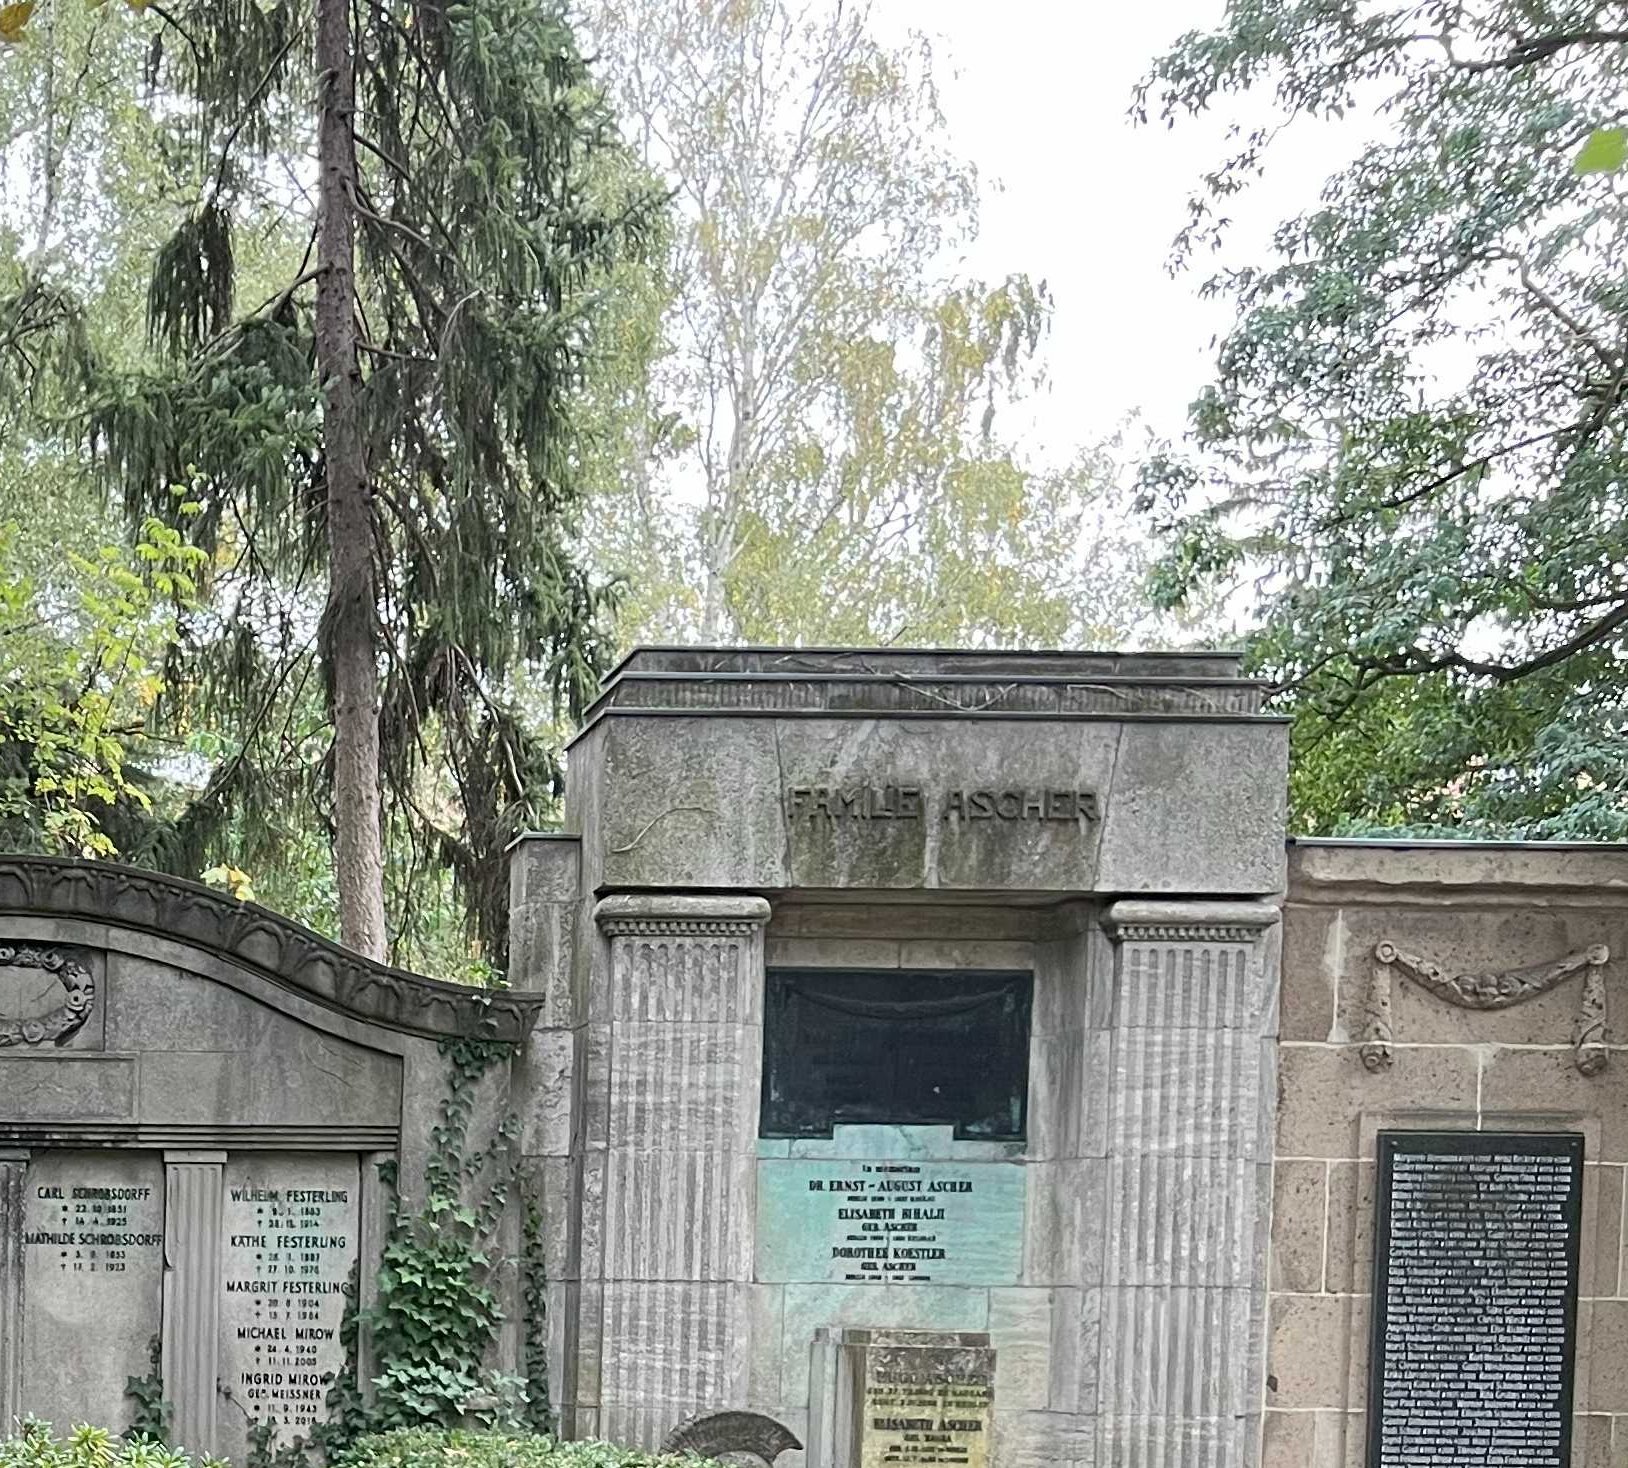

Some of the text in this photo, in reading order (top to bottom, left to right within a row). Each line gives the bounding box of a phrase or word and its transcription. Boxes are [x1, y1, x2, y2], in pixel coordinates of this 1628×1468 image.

[787, 784, 1101, 821] FAMILIE ASCHER
[829, 1180, 866, 1192] ERNST
[877, 1180, 922, 1192] AUGUST
[927, 1181, 973, 1193] ASCHER
[37, 1186, 151, 1201] CARL SCHROBSDORFF
[230, 1189, 348, 1203] WILHELM FESTERLING
[838, 1208, 896, 1220] ELISABETH
[884, 1222, 918, 1232] ASCHER
[24, 1232, 163, 1247] MATHILDE SCHROBSDORFF
[277, 1235, 346, 1249] FESTERLING
[893, 1247, 946, 1260] KOESTLER
[882, 1262, 917, 1271] ASCHER
[226, 1280, 349, 1295] MARGRIT FESTERLING
[237, 1327, 334, 1341] MICHAEL MIROW
[241, 1373, 283, 1386] INGRID
[272, 1389, 321, 1400] MEISSNER
